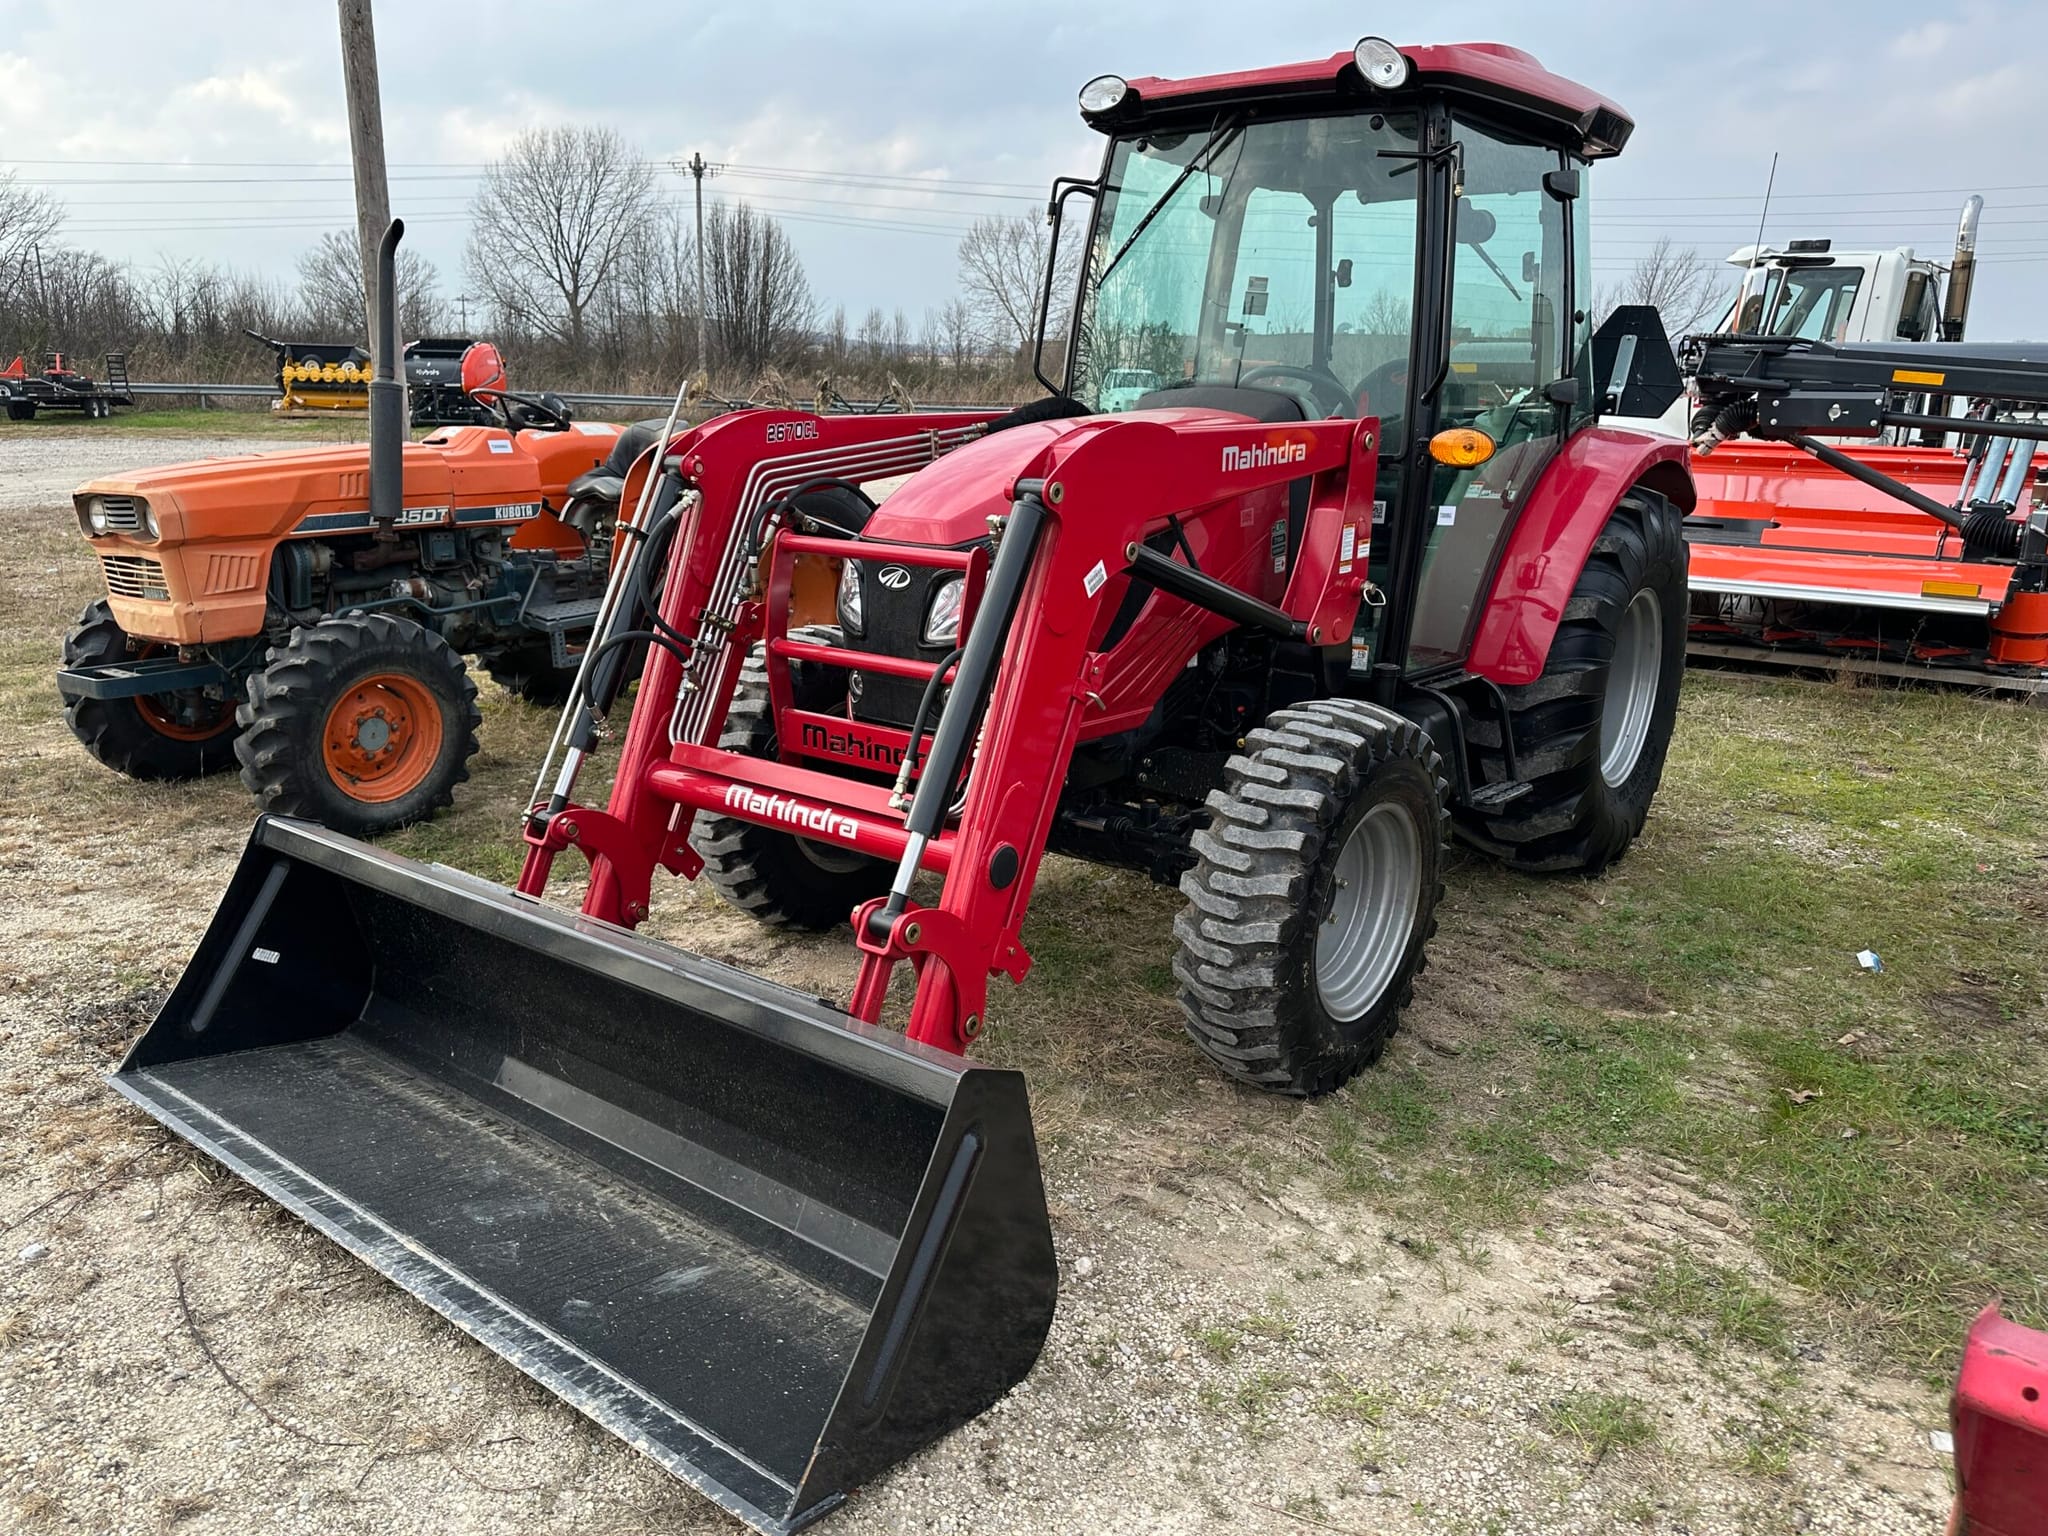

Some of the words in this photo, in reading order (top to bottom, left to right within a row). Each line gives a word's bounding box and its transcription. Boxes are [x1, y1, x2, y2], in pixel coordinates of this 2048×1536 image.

[767, 421, 819, 443] 2670CL
[1222, 440, 1306, 472] Mahindra
[495, 505, 533, 519] KUBOTA
[725, 784, 858, 839] Mahindra
